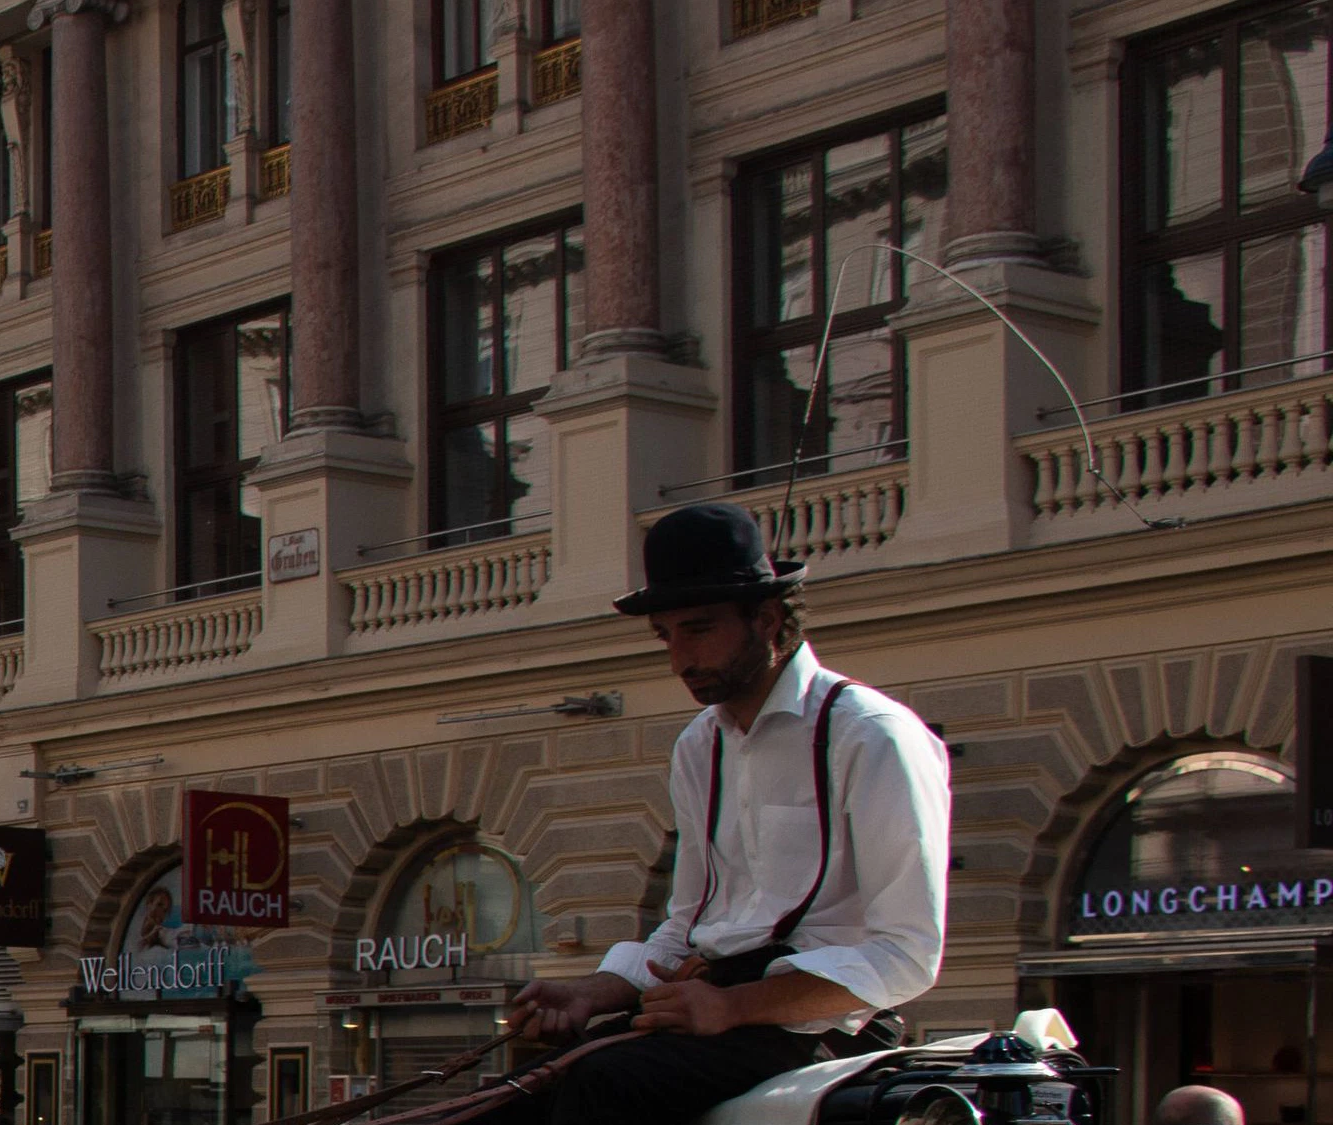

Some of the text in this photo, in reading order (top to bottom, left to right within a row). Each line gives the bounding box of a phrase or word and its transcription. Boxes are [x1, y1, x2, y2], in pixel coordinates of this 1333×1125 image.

[198, 889, 282, 919] RAUCH
[1082, 878, 1333, 918] LONGCHAMP
[80, 943, 230, 994] Wellendorff
[356, 932, 468, 972] RAUCH
